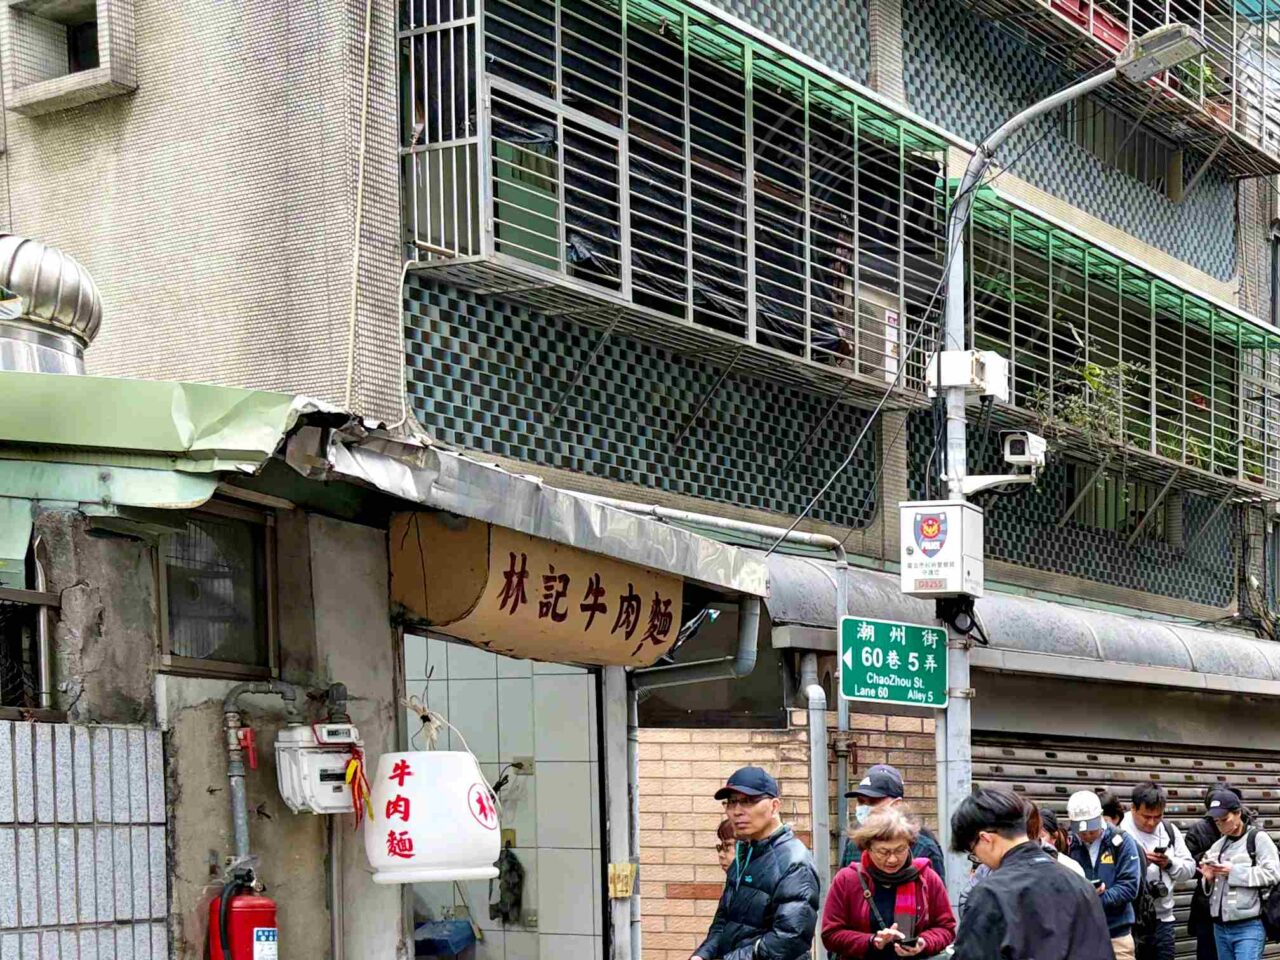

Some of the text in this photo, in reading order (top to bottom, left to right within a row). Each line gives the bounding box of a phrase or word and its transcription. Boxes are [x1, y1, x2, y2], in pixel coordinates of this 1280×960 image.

[497, 552, 673, 656] 林記牛肉麵
[857, 621, 939, 650] 潮州街
[854, 684, 934, 703] Lane 60 Alley 5
[866, 672, 925, 689] ChaoZhou St.
[385, 759, 416, 859] 牛肉麵
